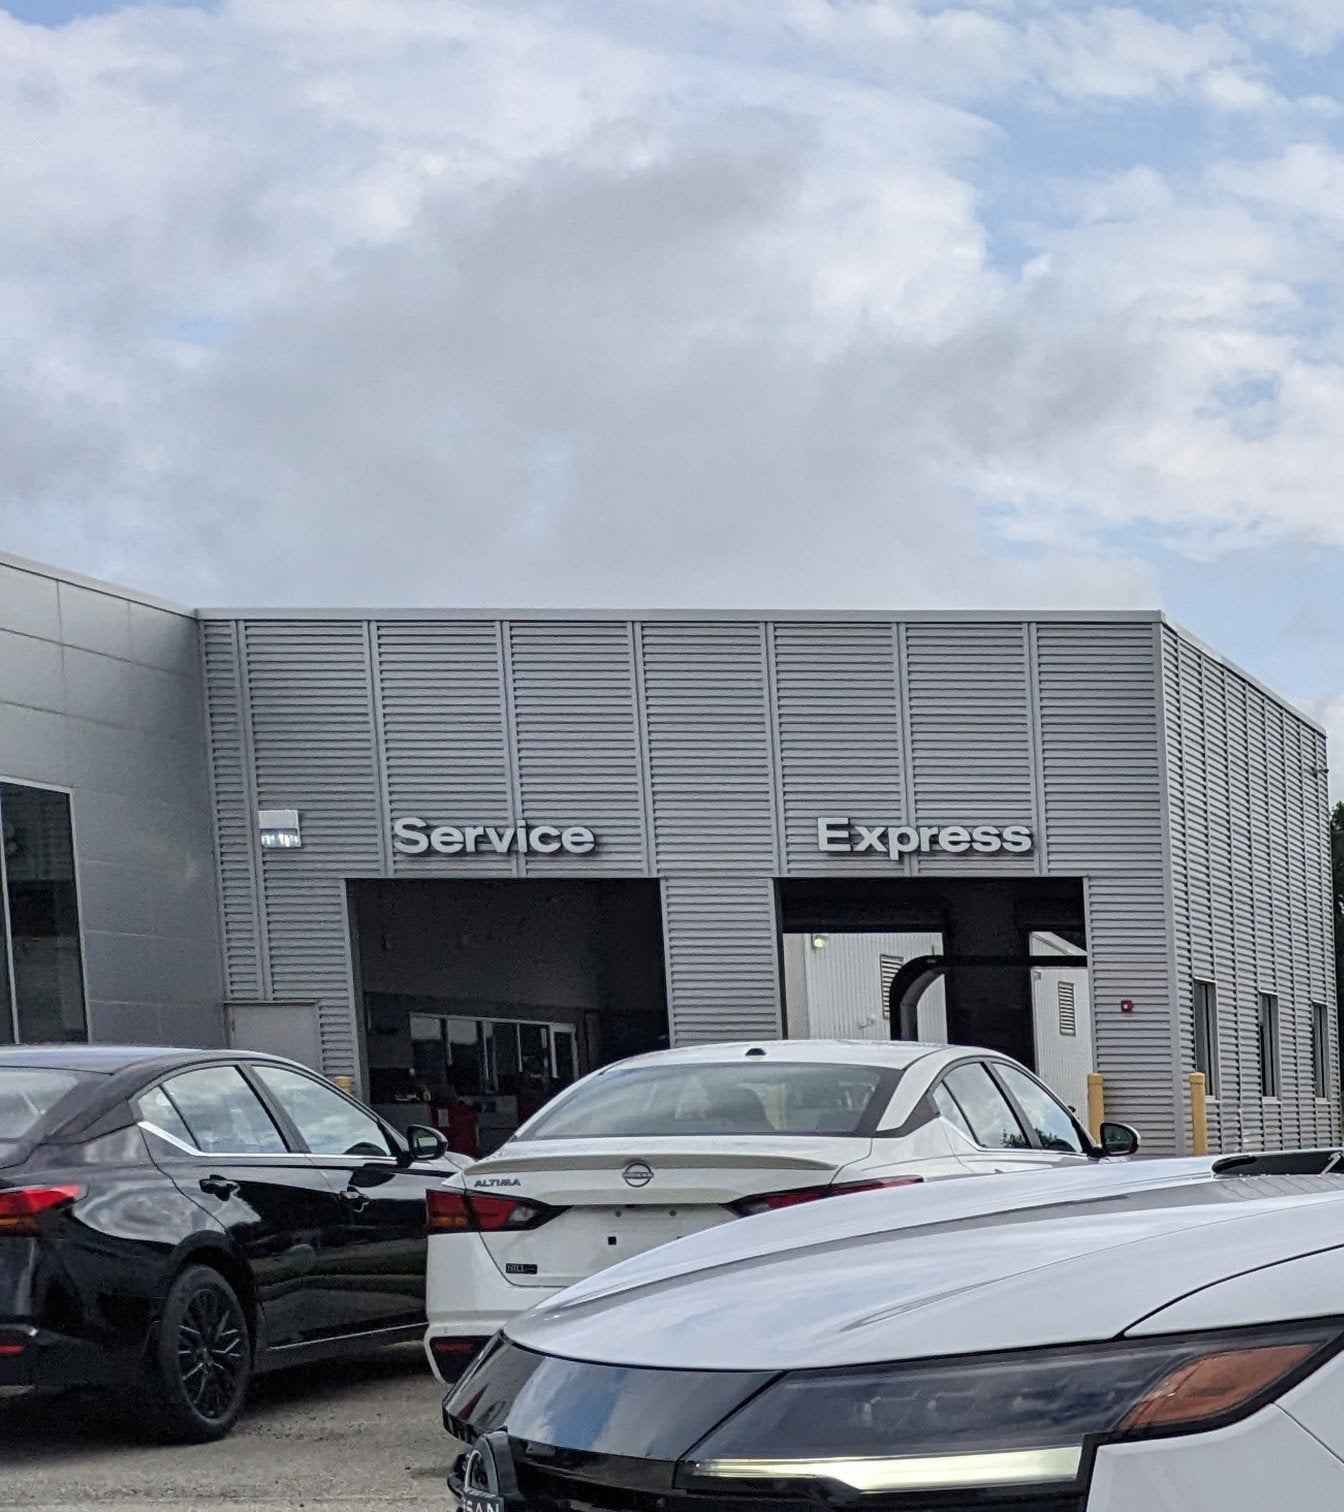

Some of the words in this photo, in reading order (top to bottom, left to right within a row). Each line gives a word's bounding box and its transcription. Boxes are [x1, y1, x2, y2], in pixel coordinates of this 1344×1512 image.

[394, 817, 596, 854] Service
[817, 817, 1032, 861] Express
[474, 1179, 522, 1188] ALTIMA
